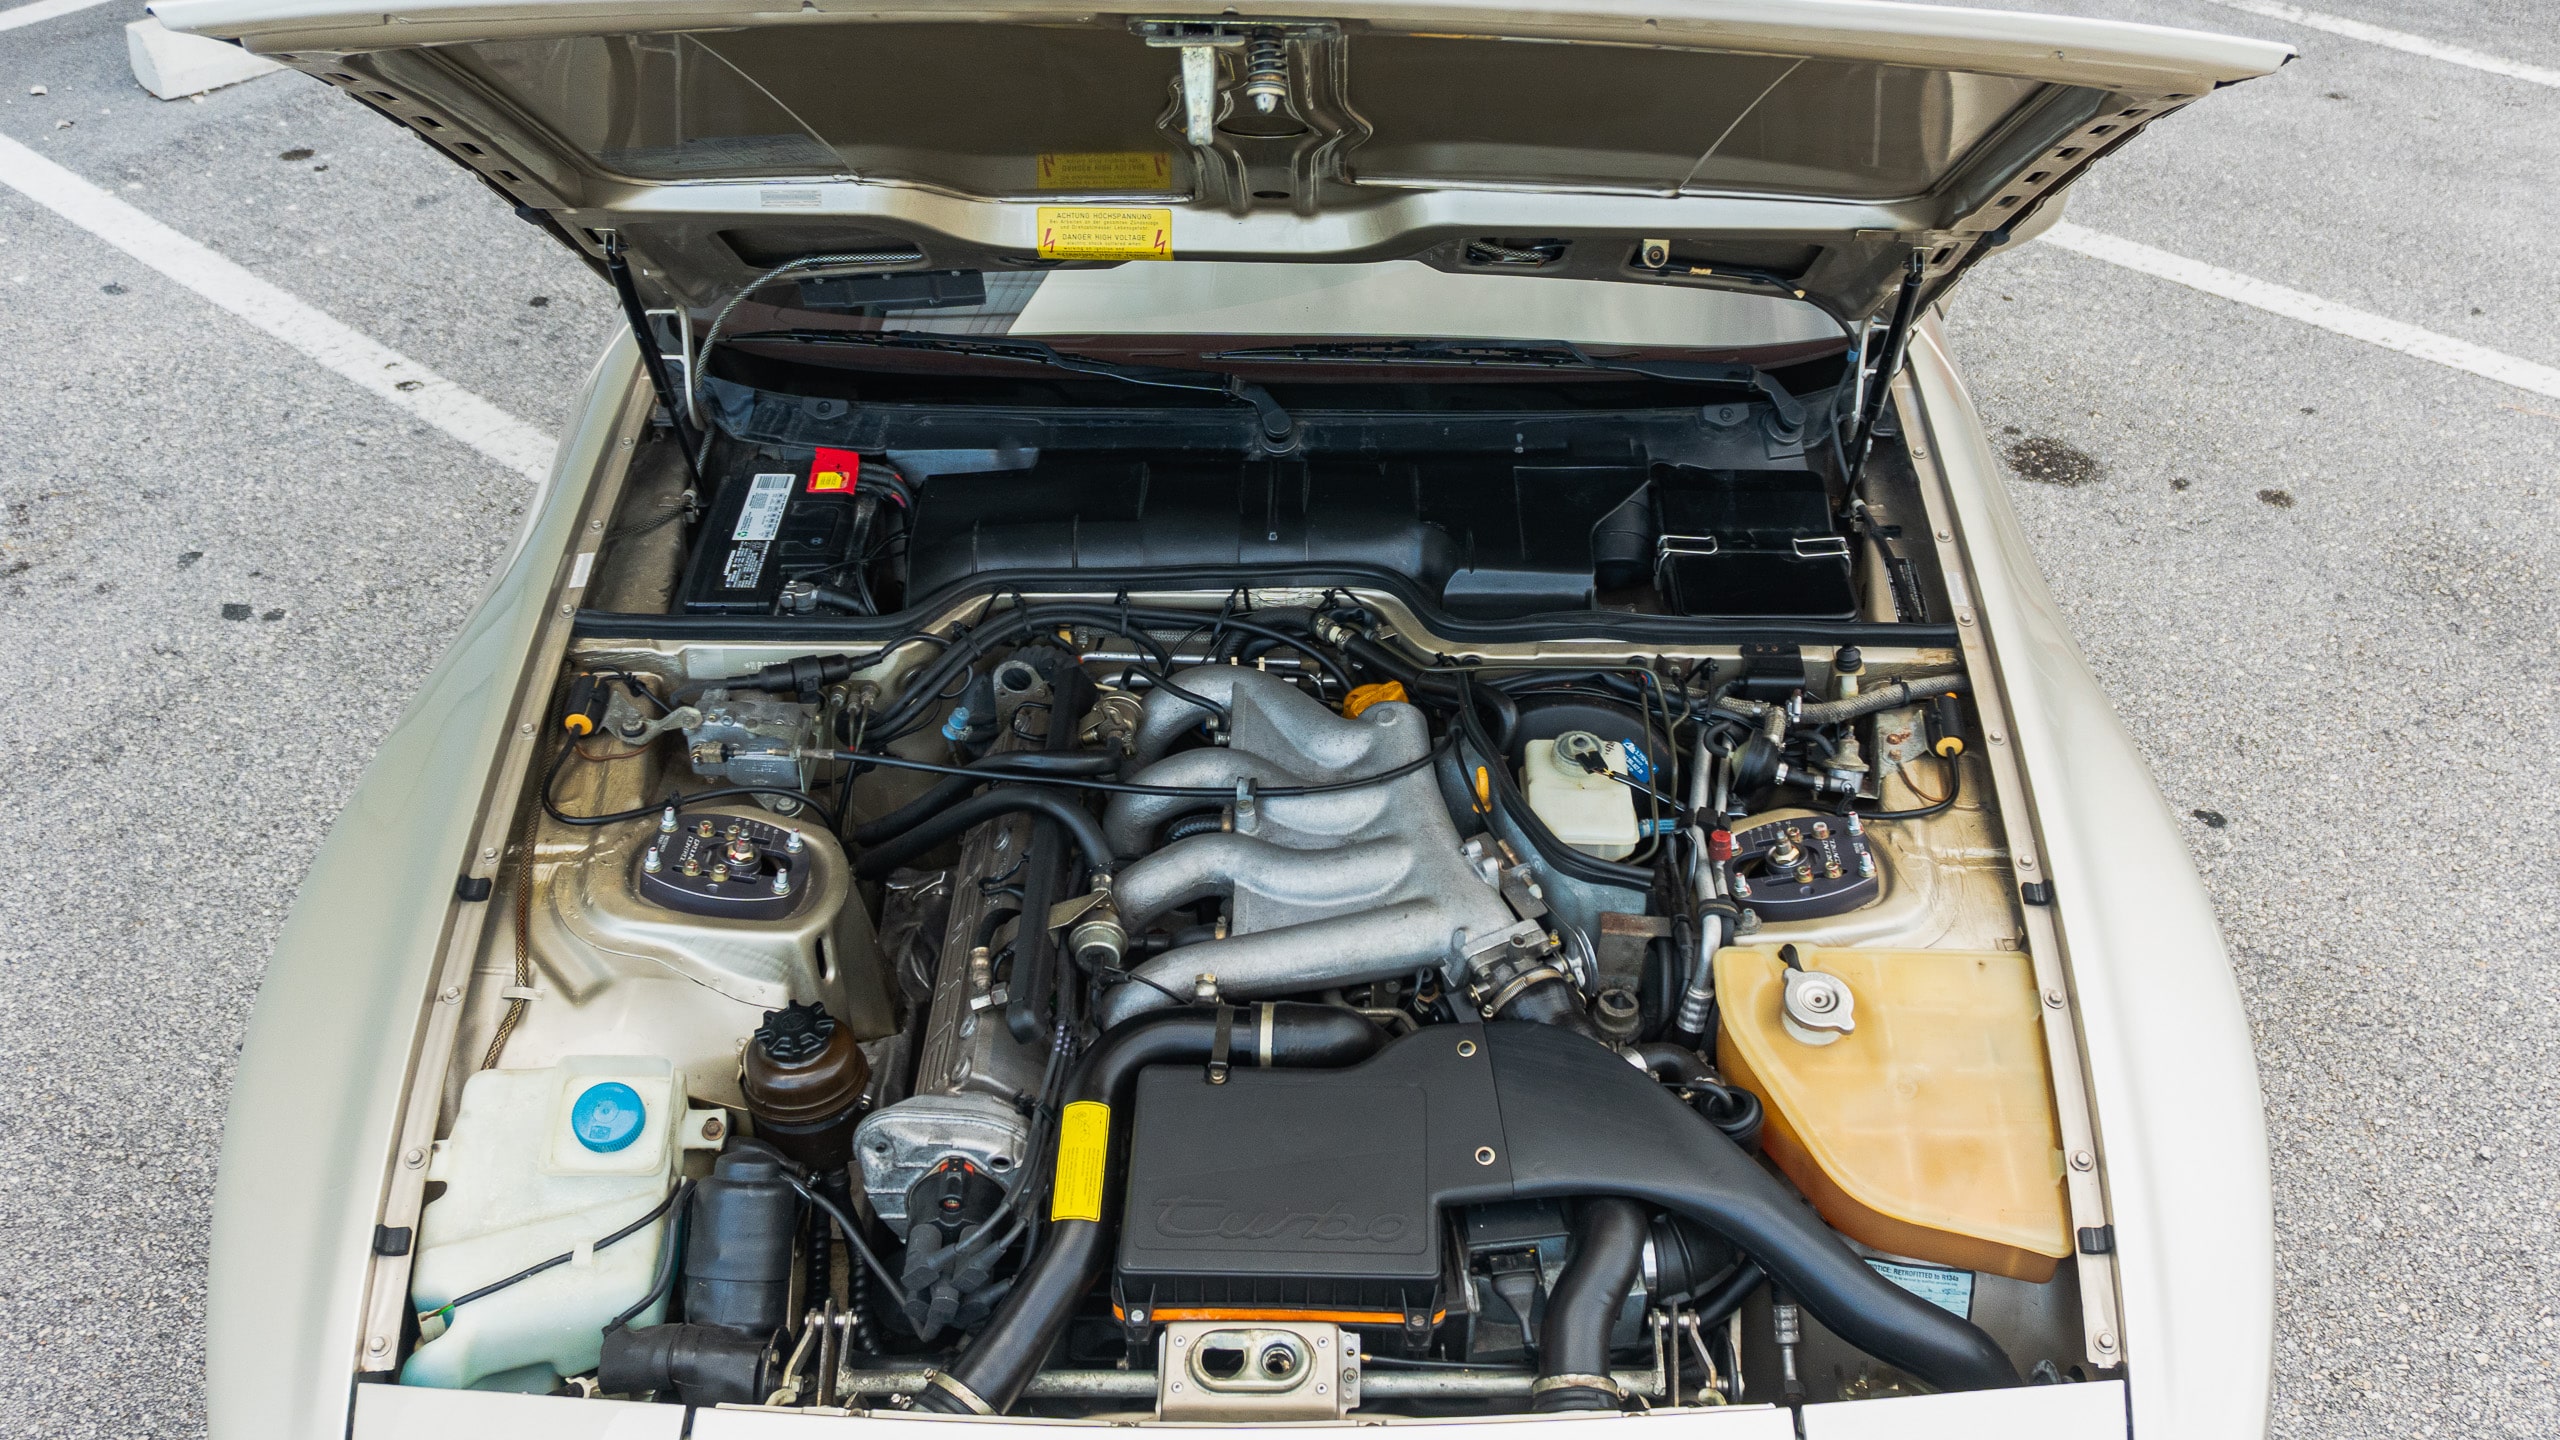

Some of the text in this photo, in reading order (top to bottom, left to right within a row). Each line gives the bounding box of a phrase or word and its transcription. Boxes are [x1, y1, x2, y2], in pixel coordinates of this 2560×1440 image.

[1062, 233, 1092, 241] DANGER
[1114, 234, 1147, 242] VOLTAGE
[1871, 1263, 1892, 1274] OTICE:
[1893, 1268, 1933, 1279] RETROFITTED
[1941, 1274, 1960, 1282] R134a
